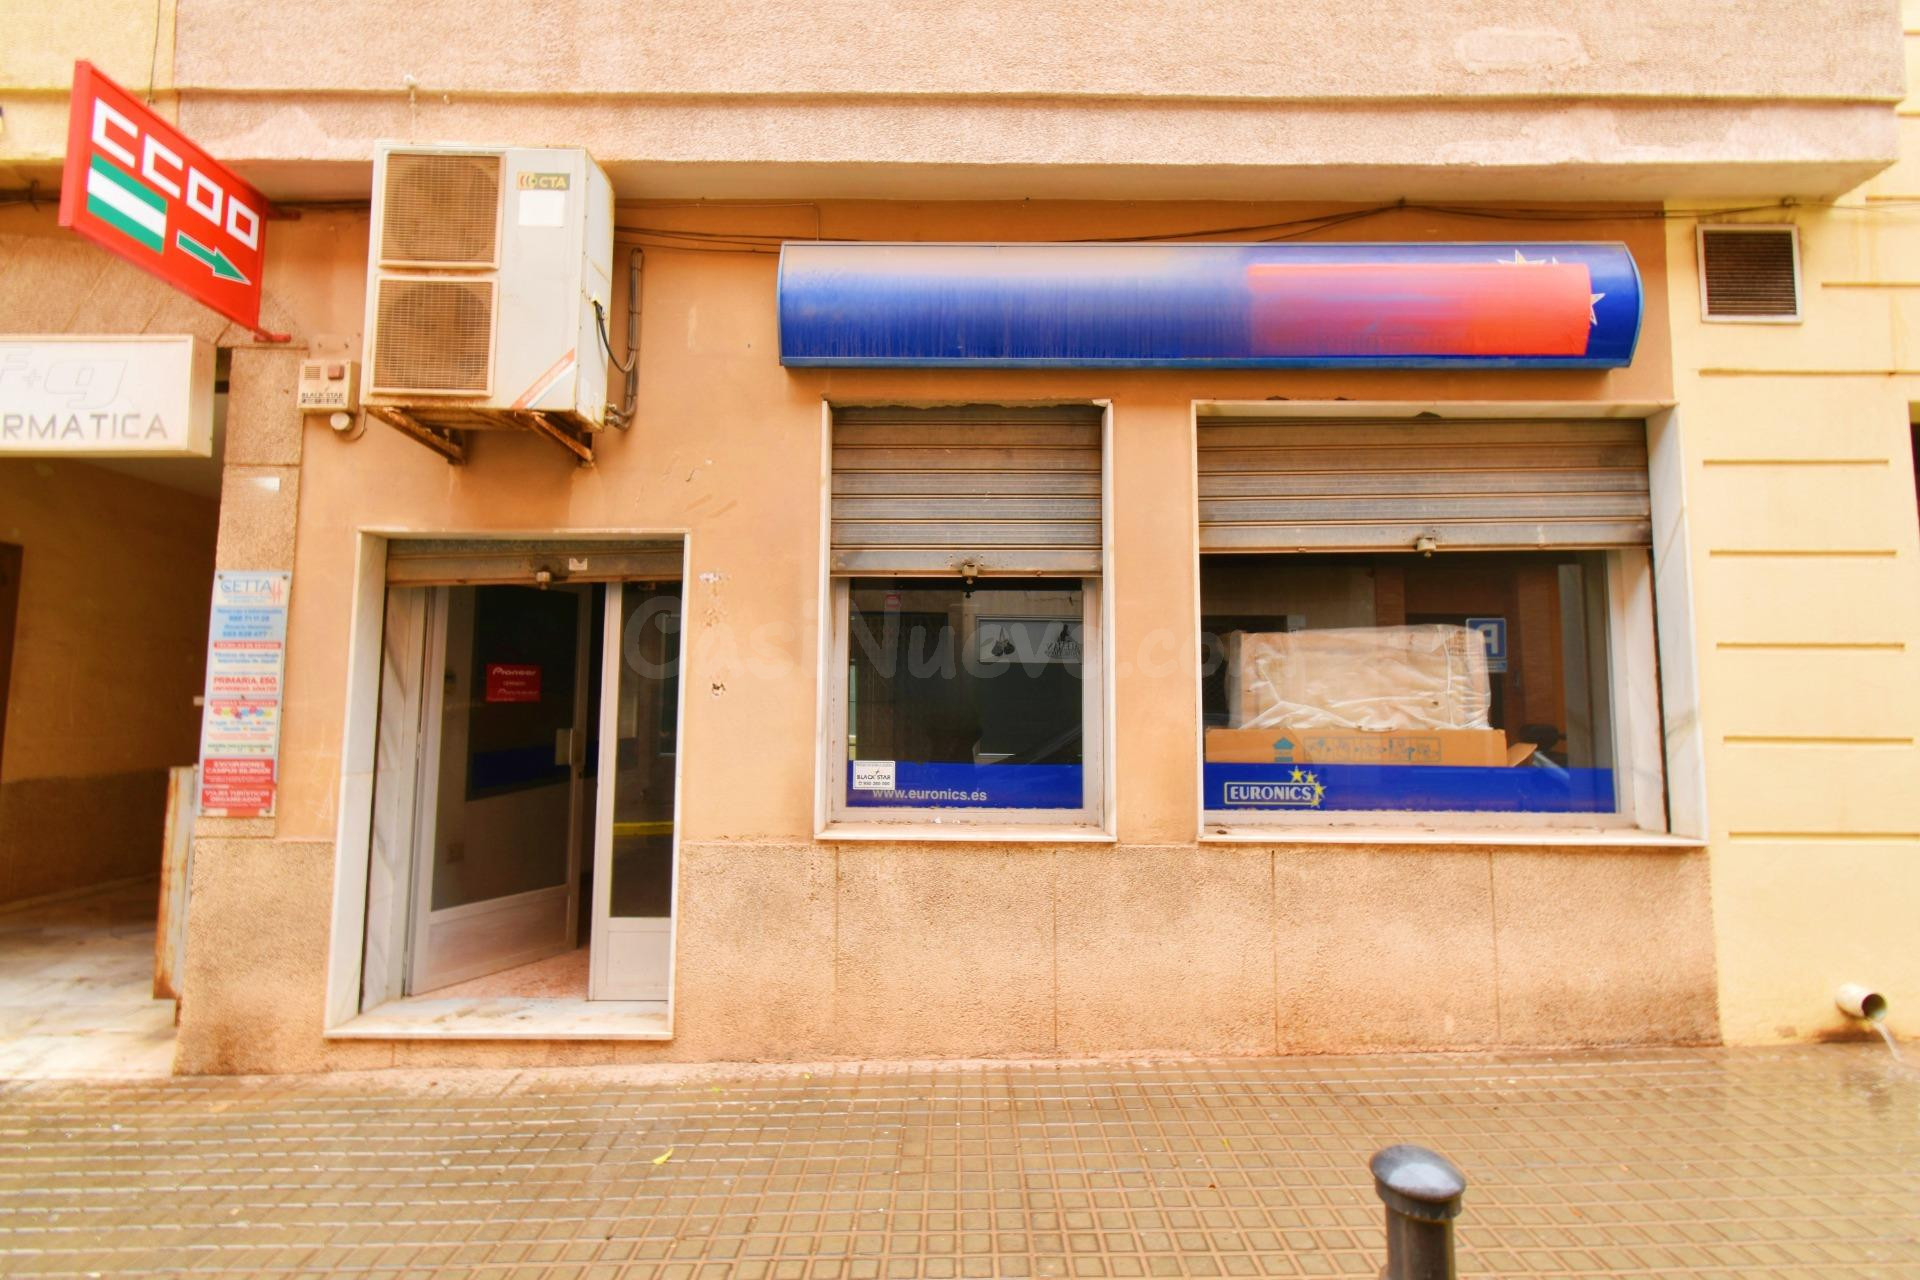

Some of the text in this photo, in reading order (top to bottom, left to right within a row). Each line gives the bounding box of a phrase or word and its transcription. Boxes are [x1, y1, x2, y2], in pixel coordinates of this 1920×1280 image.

[91, 96, 260, 252] CCOO
[538, 176, 568, 189] CTA
[872, 788, 988, 801] www.euronics.es
[1230, 786, 1312, 800] EURONICS
